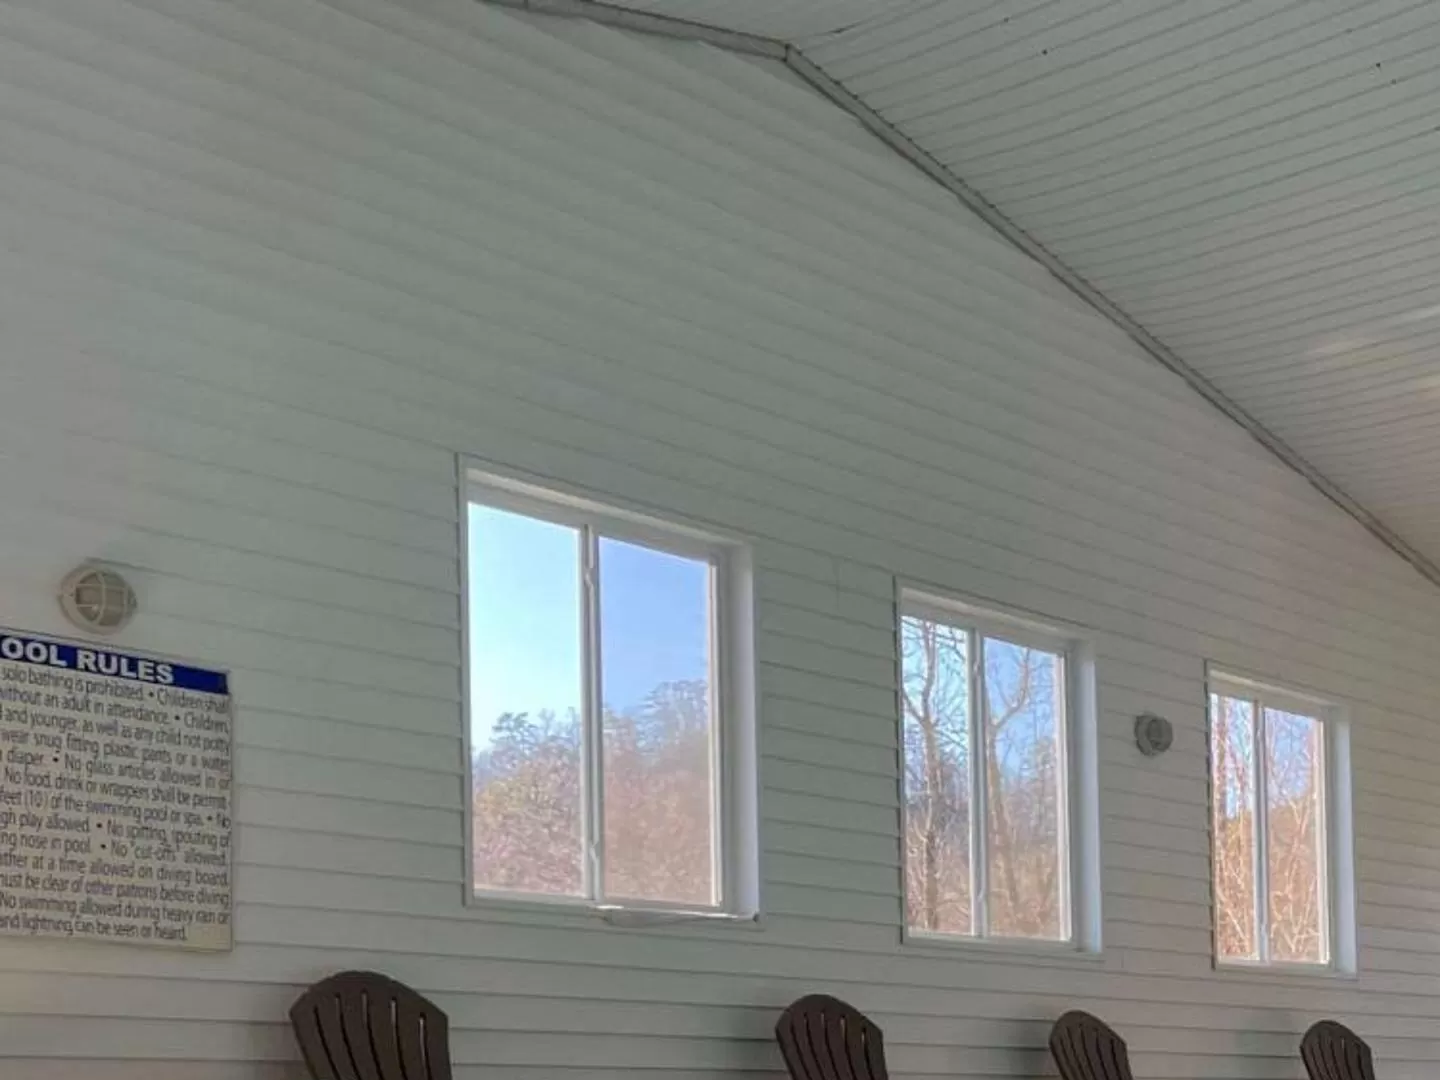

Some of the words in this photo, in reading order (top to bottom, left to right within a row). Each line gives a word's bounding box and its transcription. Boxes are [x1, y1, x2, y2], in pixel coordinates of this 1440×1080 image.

[76, 649, 174, 684] RULES
[43, 693, 58, 708] an
[60, 694, 90, 713] adult
[64, 752, 81, 770] No
[4, 766, 21, 784] No
[18, 808, 41, 832] play
